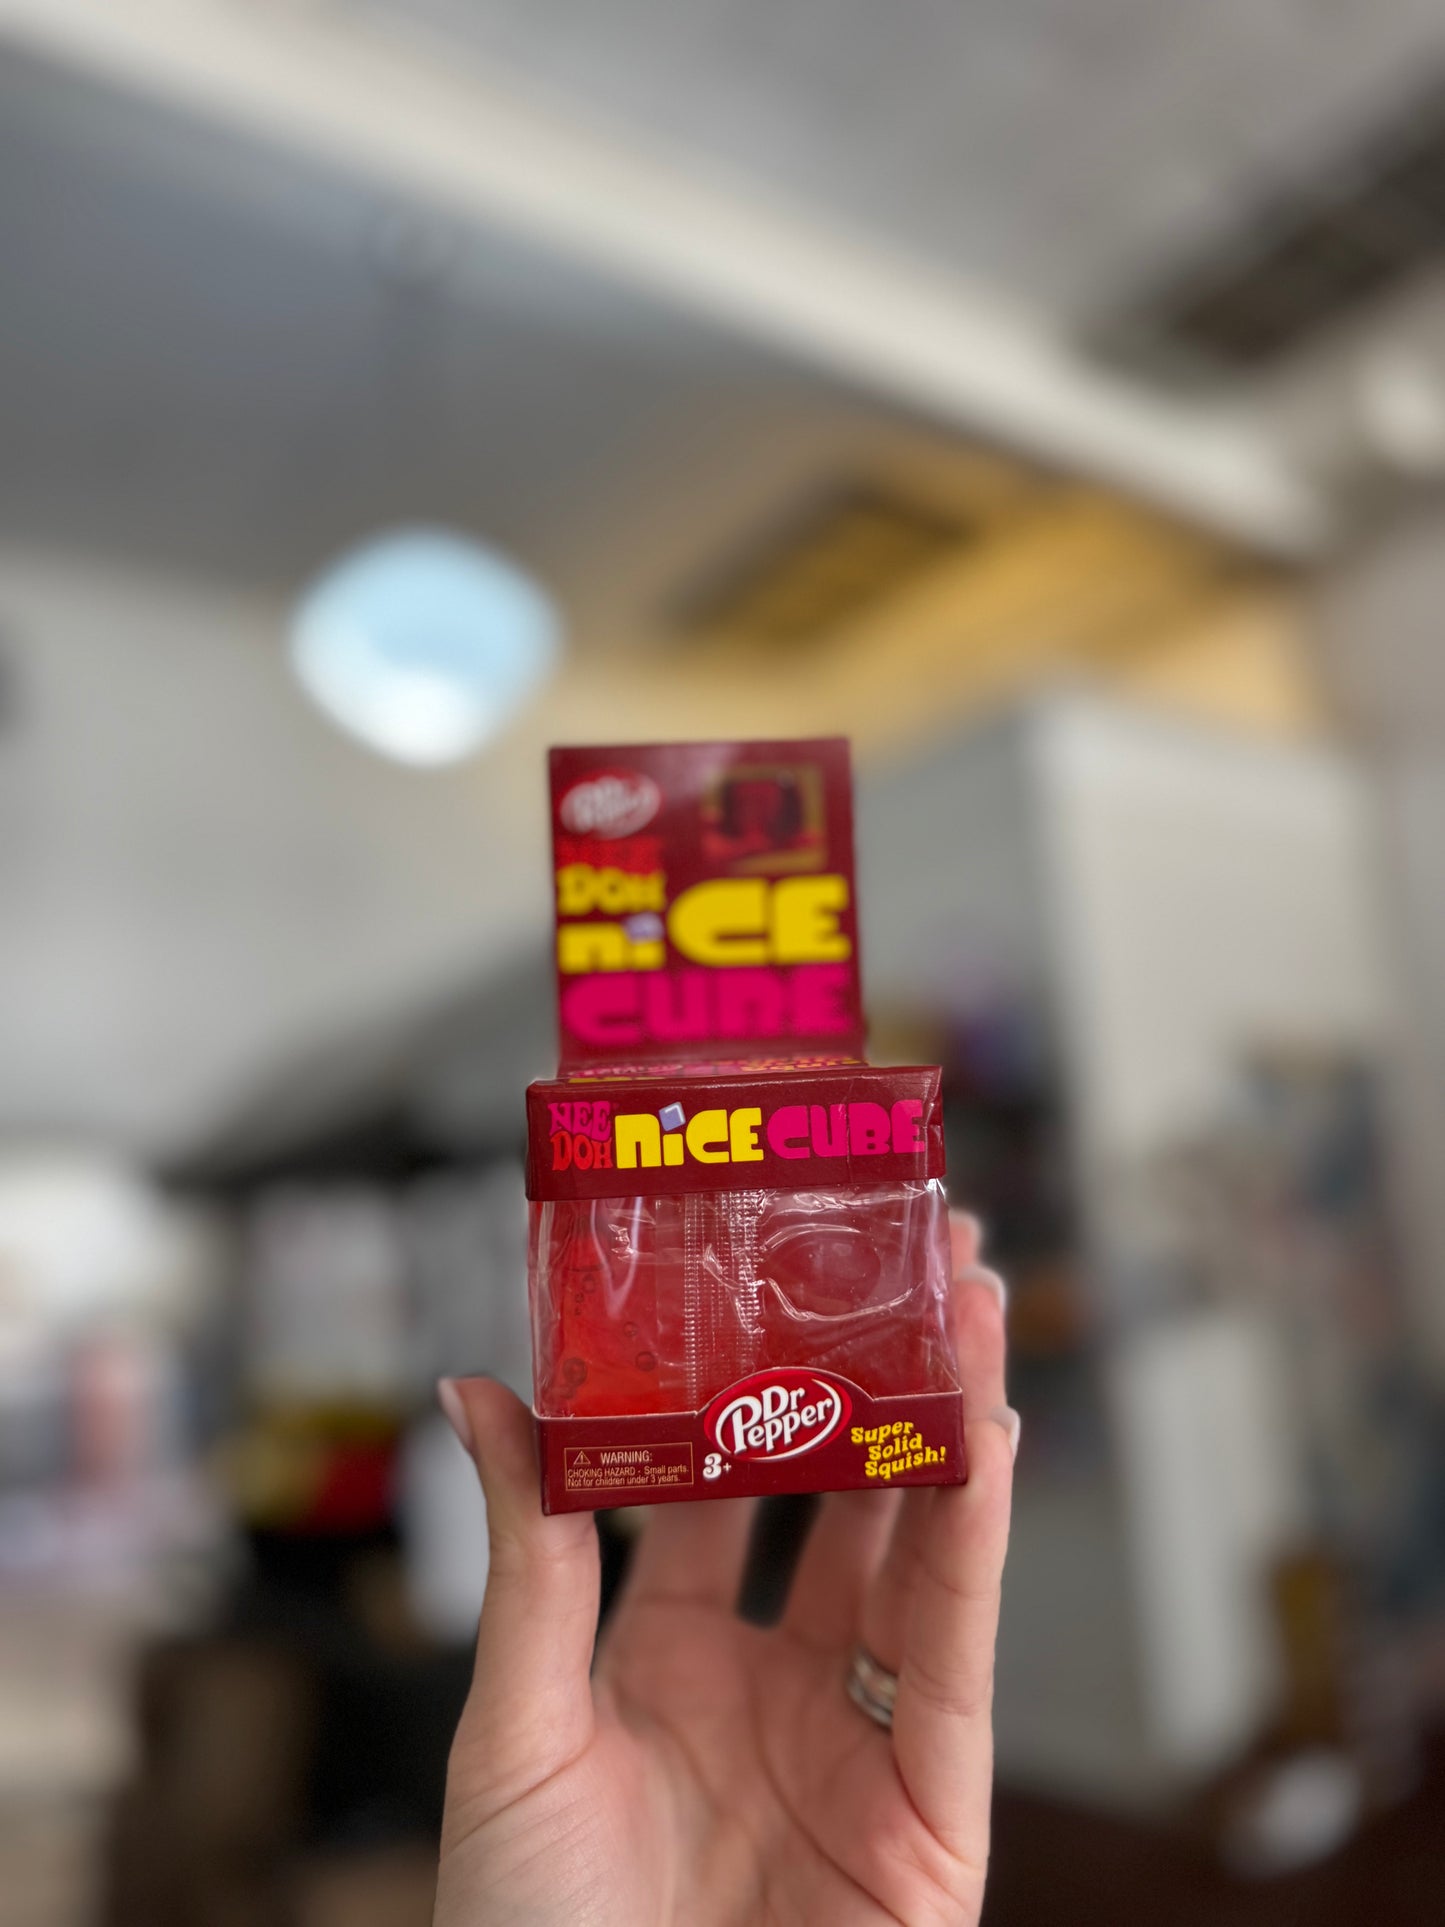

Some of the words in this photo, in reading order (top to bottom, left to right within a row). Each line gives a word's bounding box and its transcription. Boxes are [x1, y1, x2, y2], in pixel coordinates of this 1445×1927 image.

[548, 1101, 611, 1142] NEE
[767, 1099, 925, 1160] CUBE
[550, 1131, 613, 1171] DOH
[761, 1385, 806, 1421] Dr
[716, 1395, 833, 1454] Pepper
[851, 1421, 914, 1445] Super
[600, 1450, 653, 1465] WARNING:
[868, 1433, 922, 1461] Solid
[567, 1465, 603, 1479] CHOKING
[604, 1463, 636, 1477] HAZARD
[644, 1464, 666, 1475] Small
[702, 1452, 732, 1480] 3+
[864, 1446, 947, 1480] Squish!
[567, 1477, 582, 1487] Not
[583, 1476, 594, 1487] for
[595, 1474, 625, 1486] children
[627, 1474, 649, 1485] under
